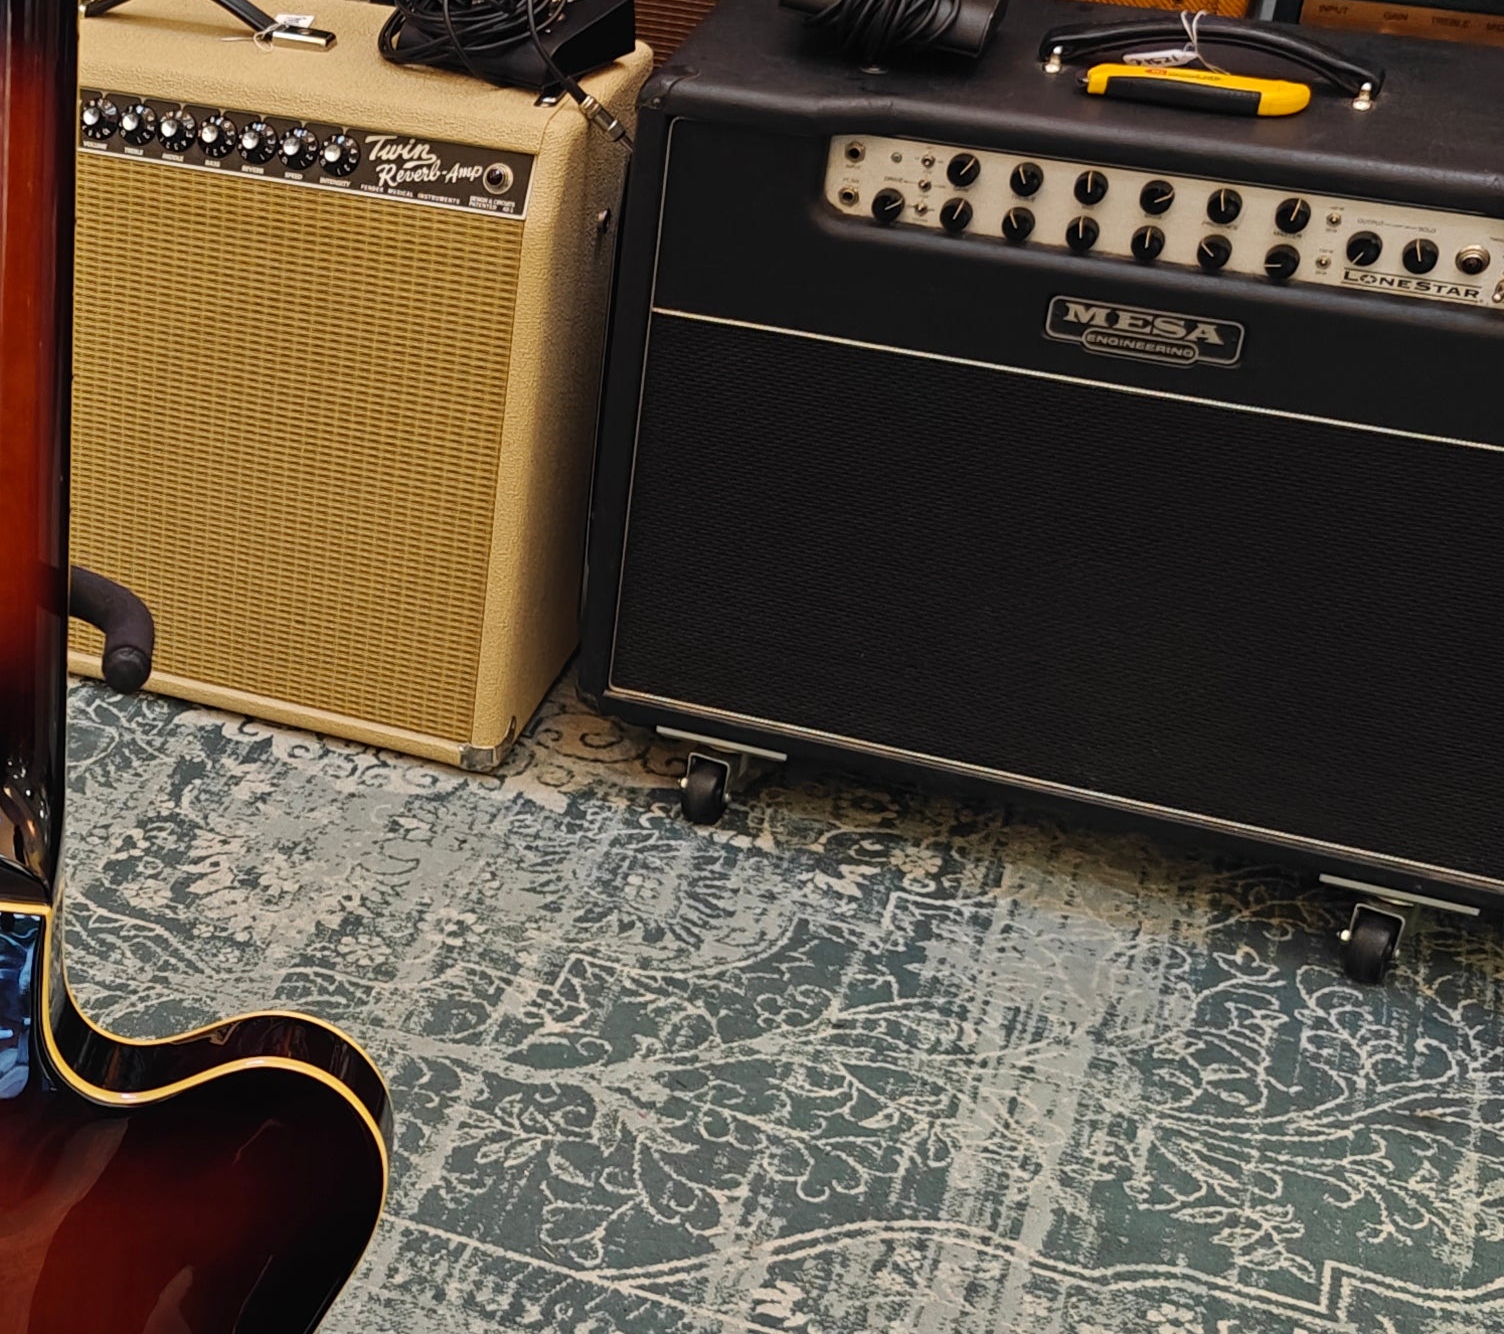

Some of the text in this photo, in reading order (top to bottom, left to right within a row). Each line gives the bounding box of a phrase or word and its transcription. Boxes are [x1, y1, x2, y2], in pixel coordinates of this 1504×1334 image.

[365, 135, 438, 168] Twin
[361, 183, 460, 205] FENDER MUSICAL INSTRUMENTS
[1063, 302, 1224, 345] MESA
[1087, 334, 1194, 358] ENGINEERING
